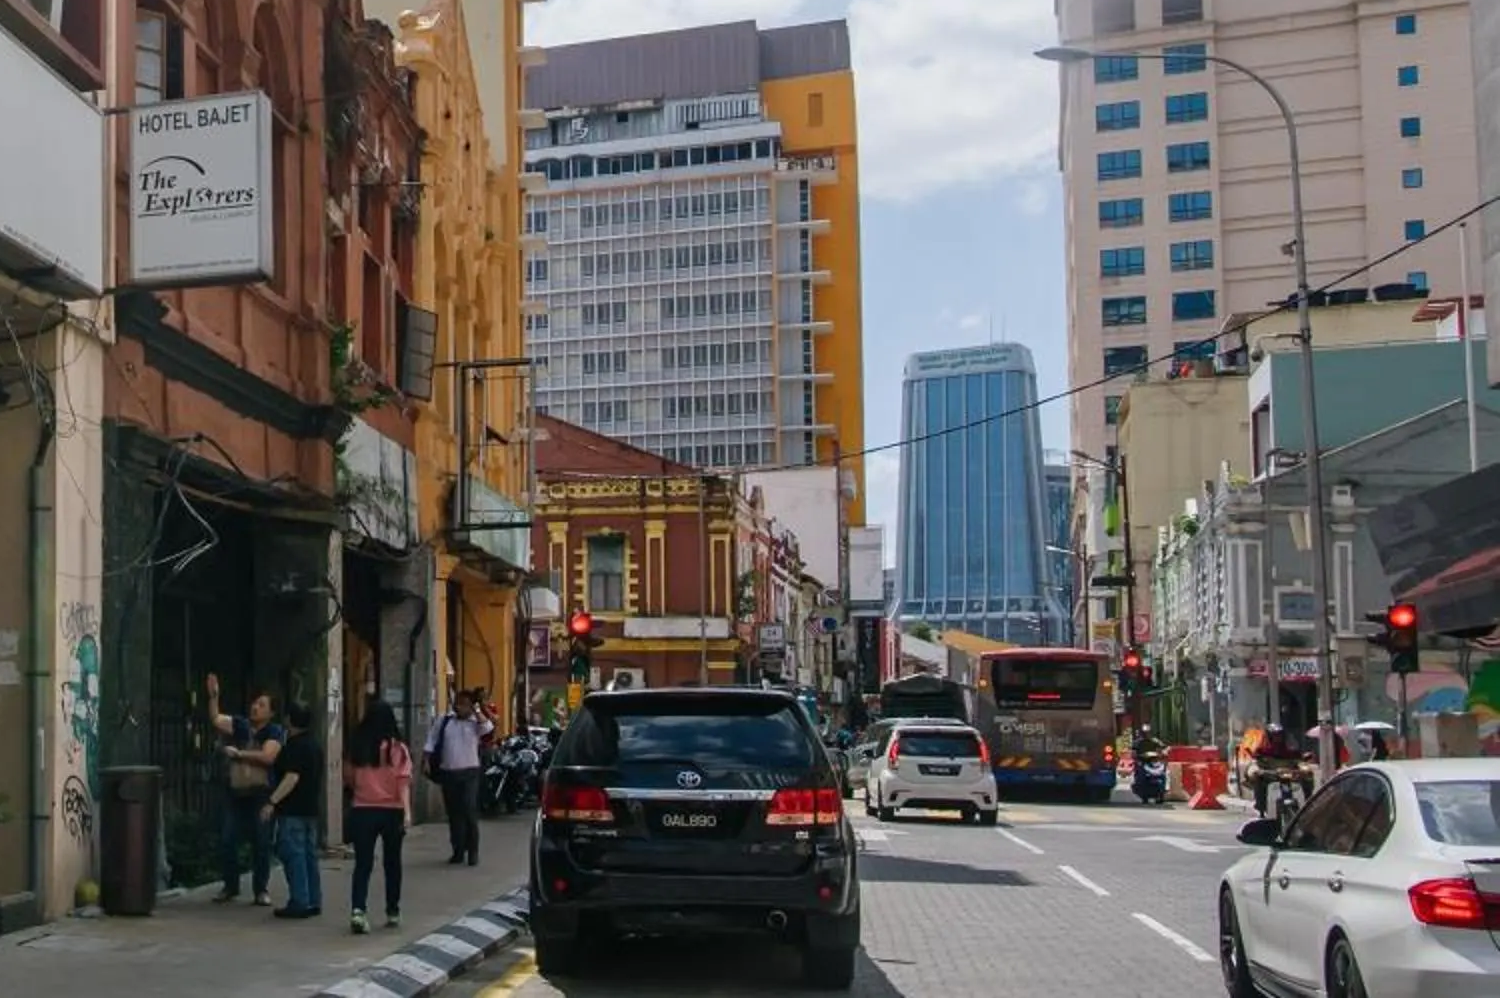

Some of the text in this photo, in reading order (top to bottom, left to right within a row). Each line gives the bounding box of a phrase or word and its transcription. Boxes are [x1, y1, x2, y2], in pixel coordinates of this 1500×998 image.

[139, 103, 253, 134] HOTEL BAJET
[139, 170, 177, 190] The
[143, 186, 255, 215] Explorers
